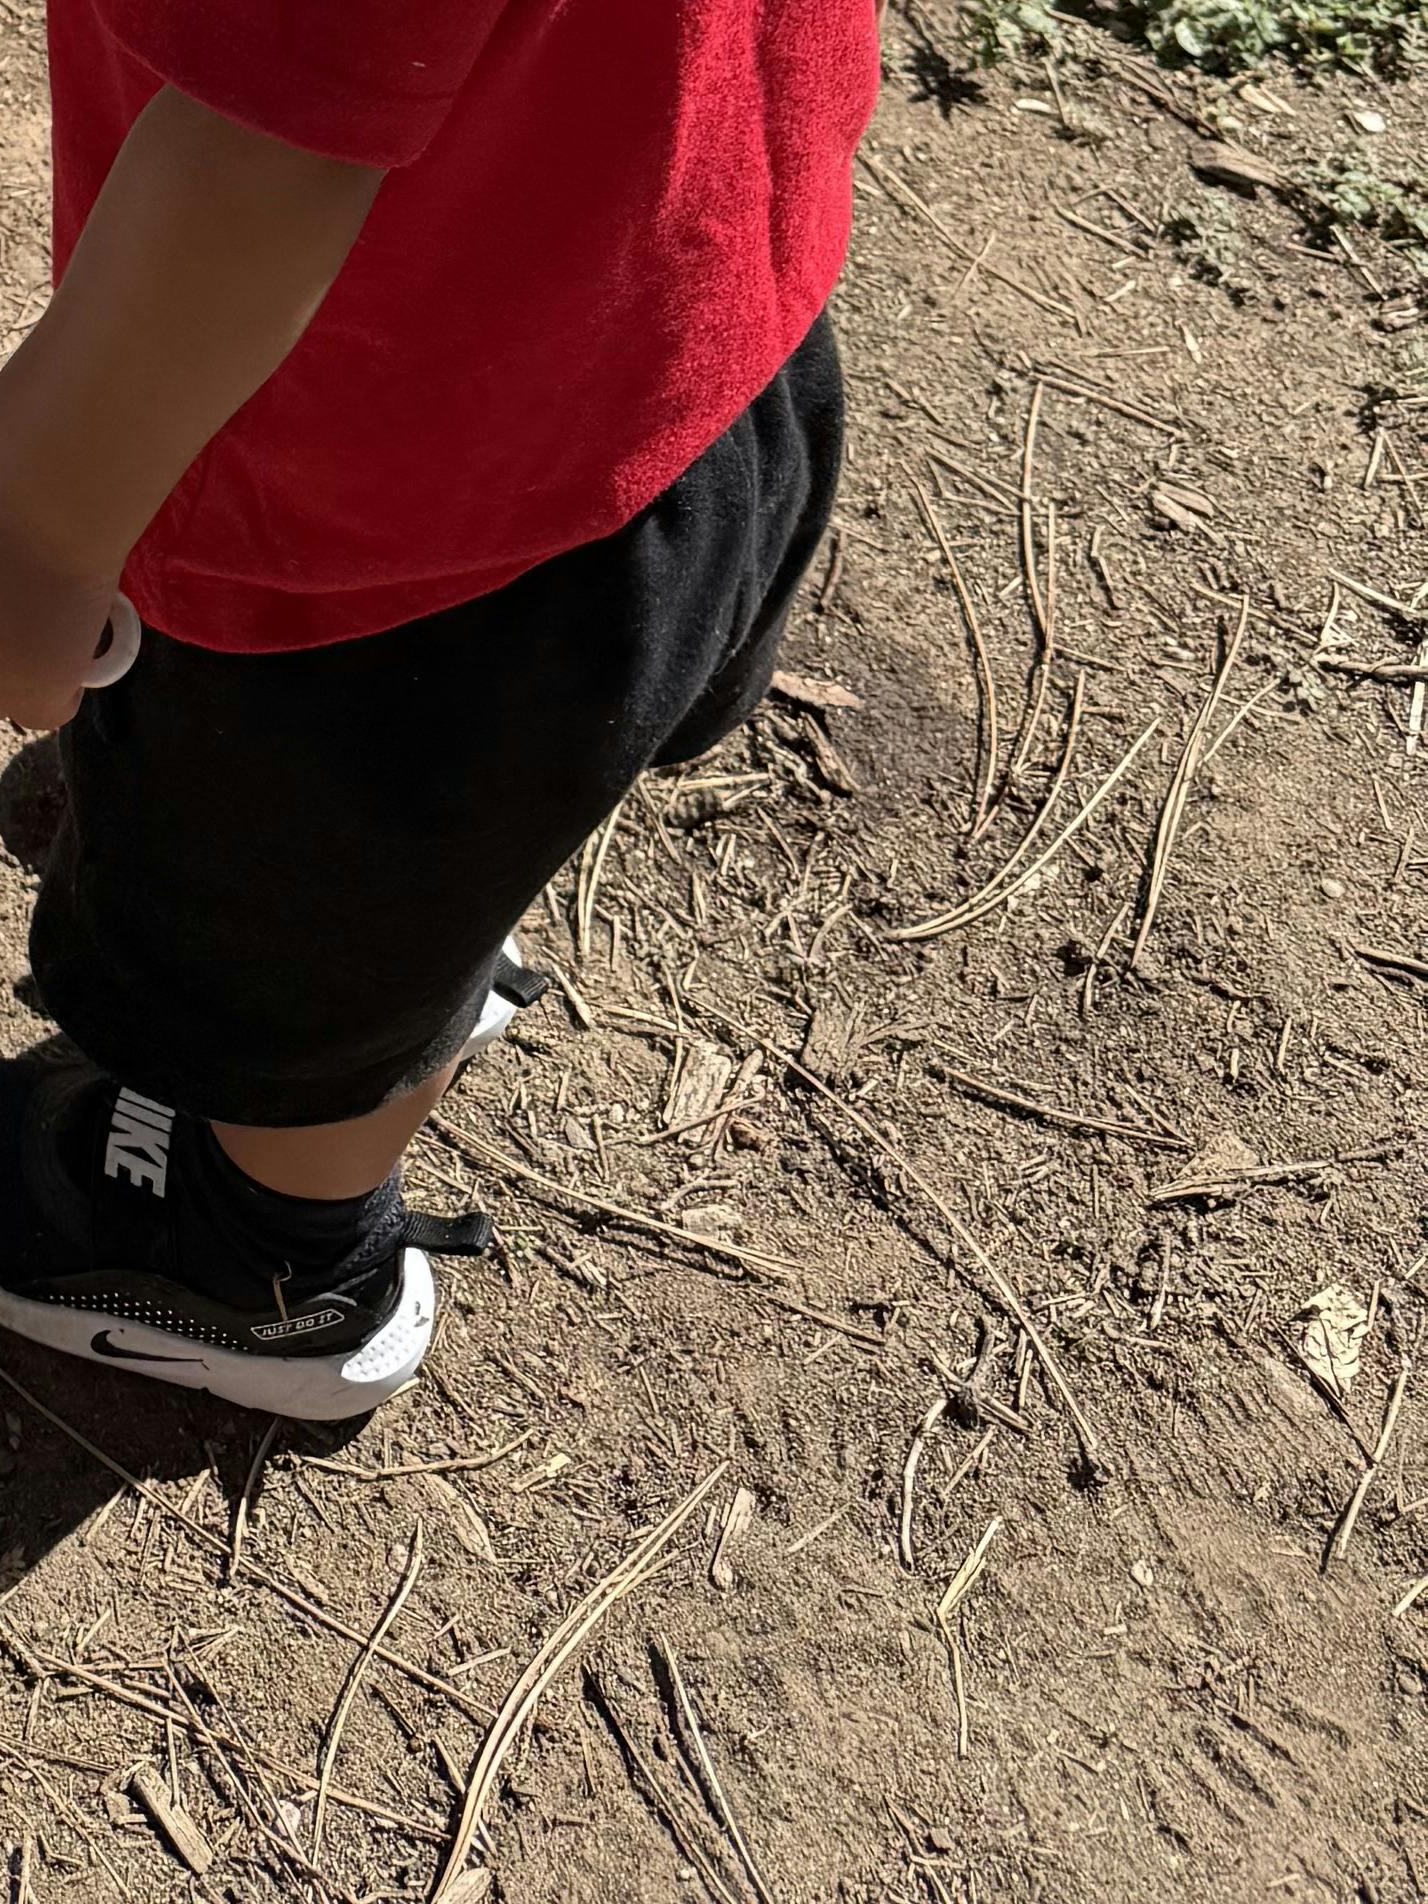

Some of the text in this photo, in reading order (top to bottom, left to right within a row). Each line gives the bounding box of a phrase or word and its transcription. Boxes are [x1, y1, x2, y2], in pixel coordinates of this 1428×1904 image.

[262, 1312, 333, 1336] JUST DO IT
